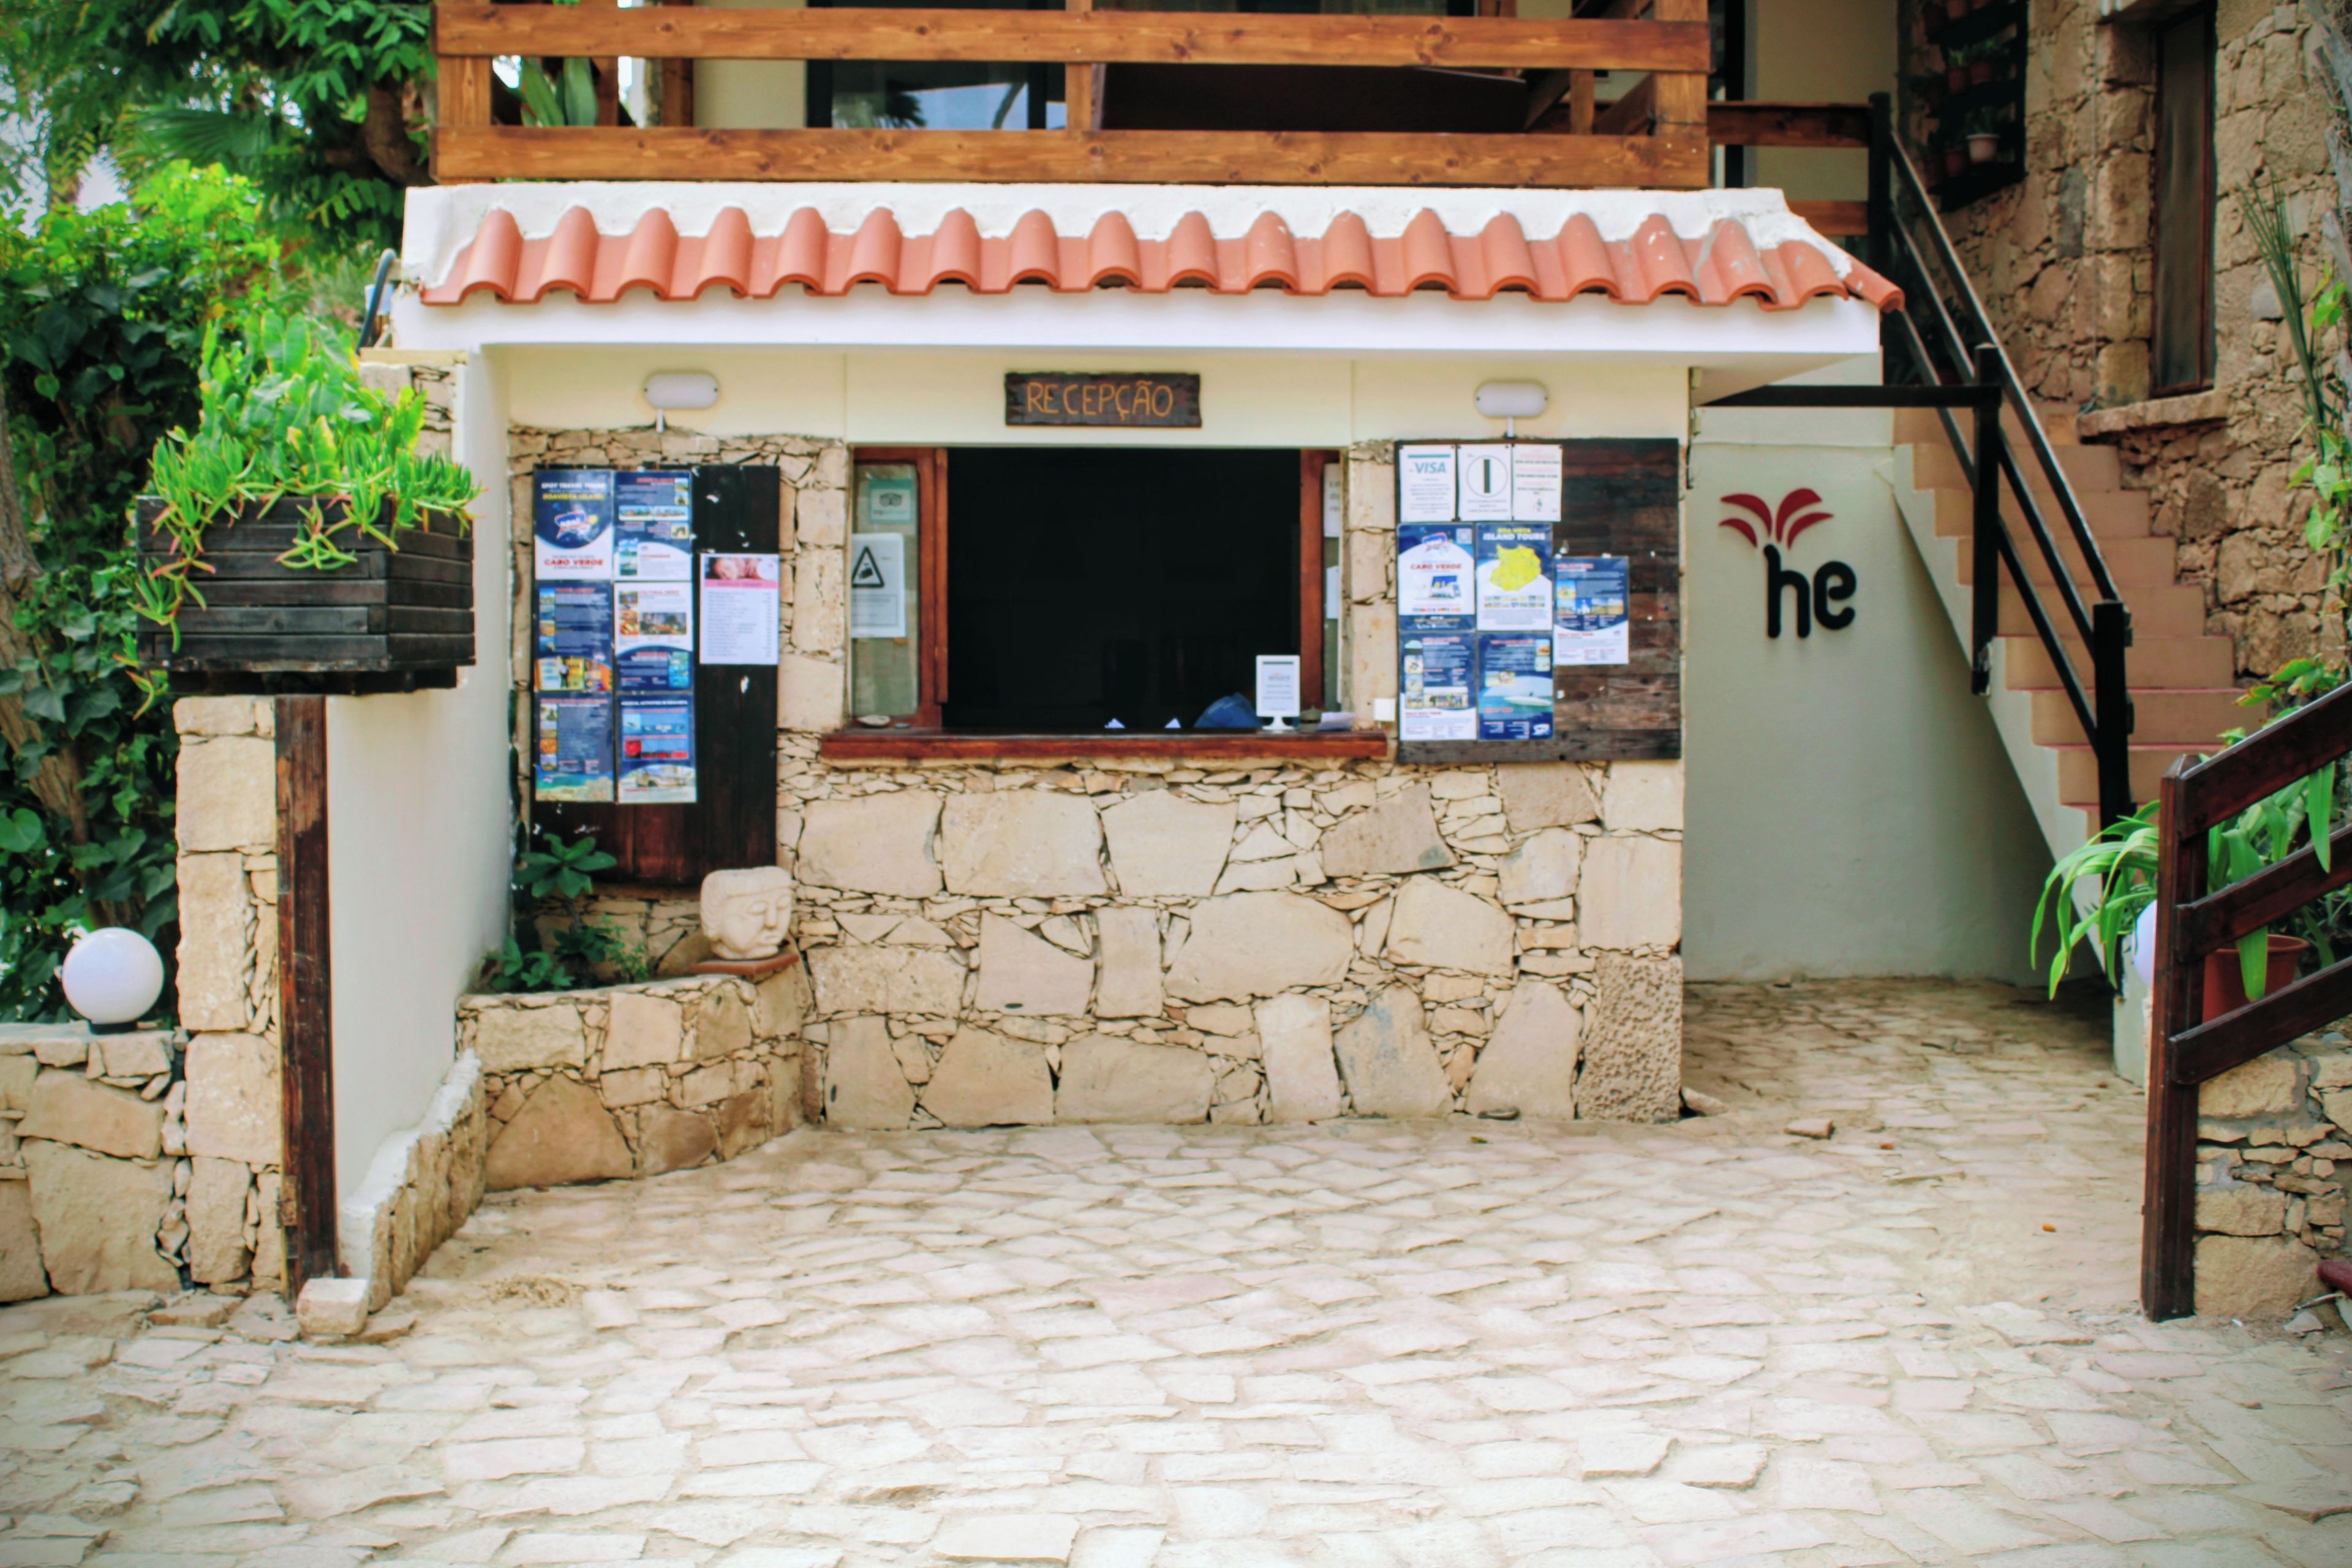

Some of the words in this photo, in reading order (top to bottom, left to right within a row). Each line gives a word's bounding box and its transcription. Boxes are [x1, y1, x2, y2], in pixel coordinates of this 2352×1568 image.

[1027, 380, 1174, 421] RECEPÇÃO
[1414, 461, 1446, 473] VISA
[1763, 543, 1856, 639] he
